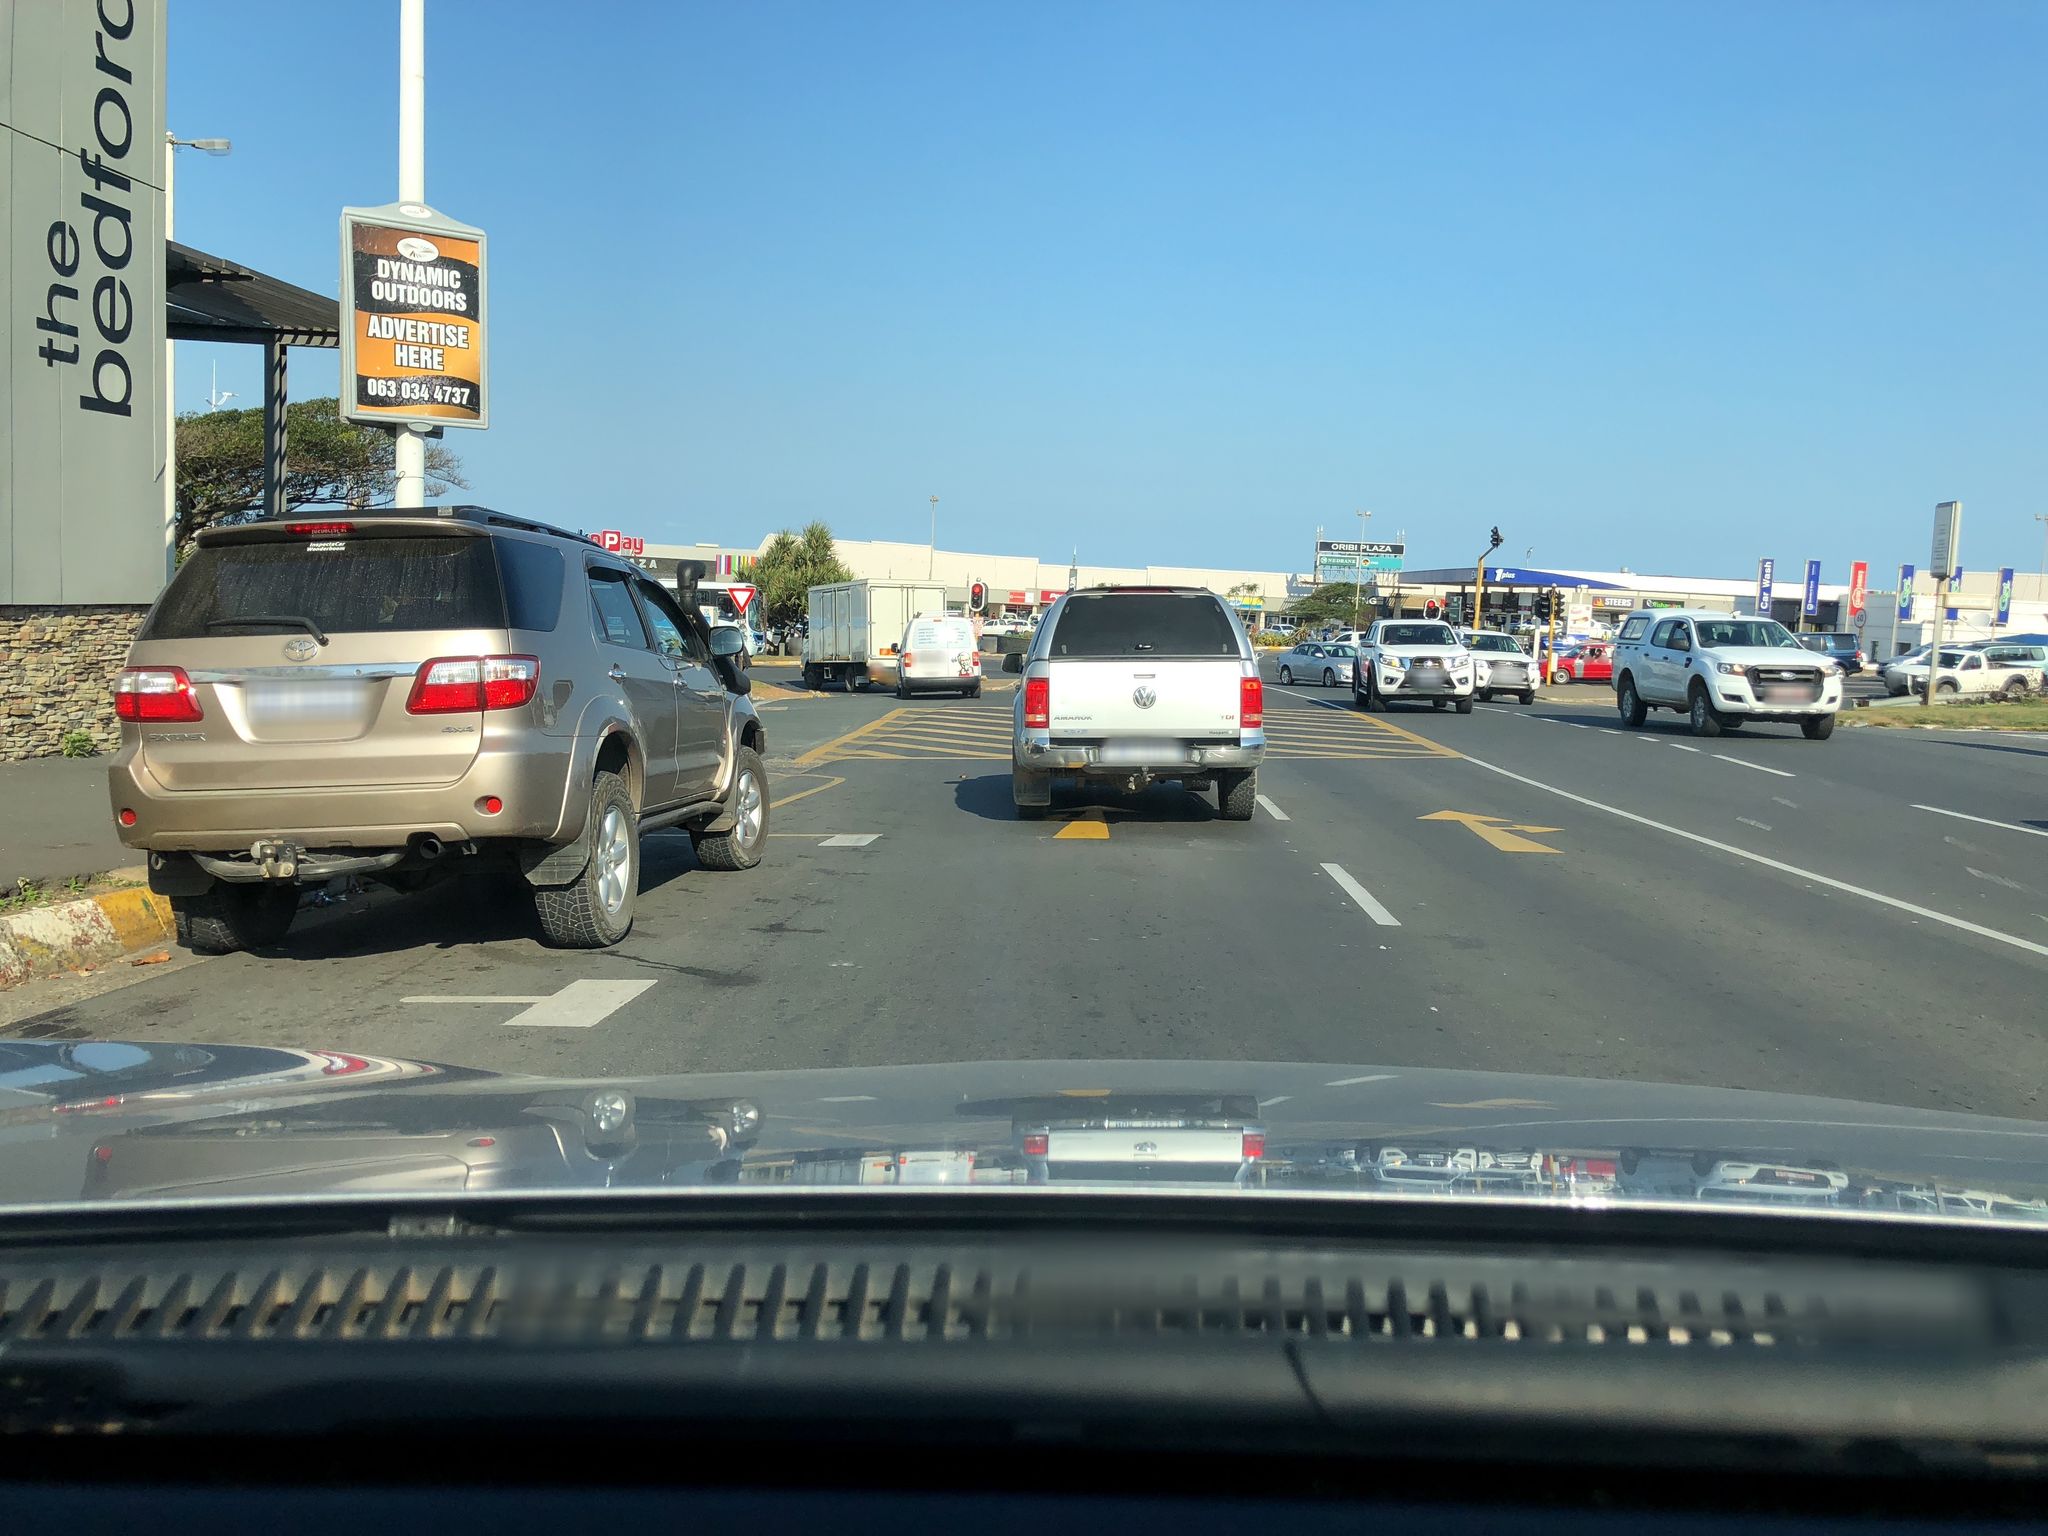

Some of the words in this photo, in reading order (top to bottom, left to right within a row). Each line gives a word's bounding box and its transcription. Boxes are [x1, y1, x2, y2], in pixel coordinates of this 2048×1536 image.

[377, 259, 461, 289] DYNAMIC
[36, 220, 80, 368] the
[371, 280, 468, 312] OUTDOORS
[366, 313, 469, 350] ADVERTISE
[394, 342, 445, 371] HERE
[367, 378, 397, 398] 063
[401, 381, 430, 401] 034
[433, 385, 470, 405] 4737
[603, 531, 644, 555] Pay
[1331, 543, 1358, 551] ORIBI
[1762, 561, 1773, 588] Wash
[1604, 597, 1632, 607] STEERS
[1760, 592, 1770, 610] Car
